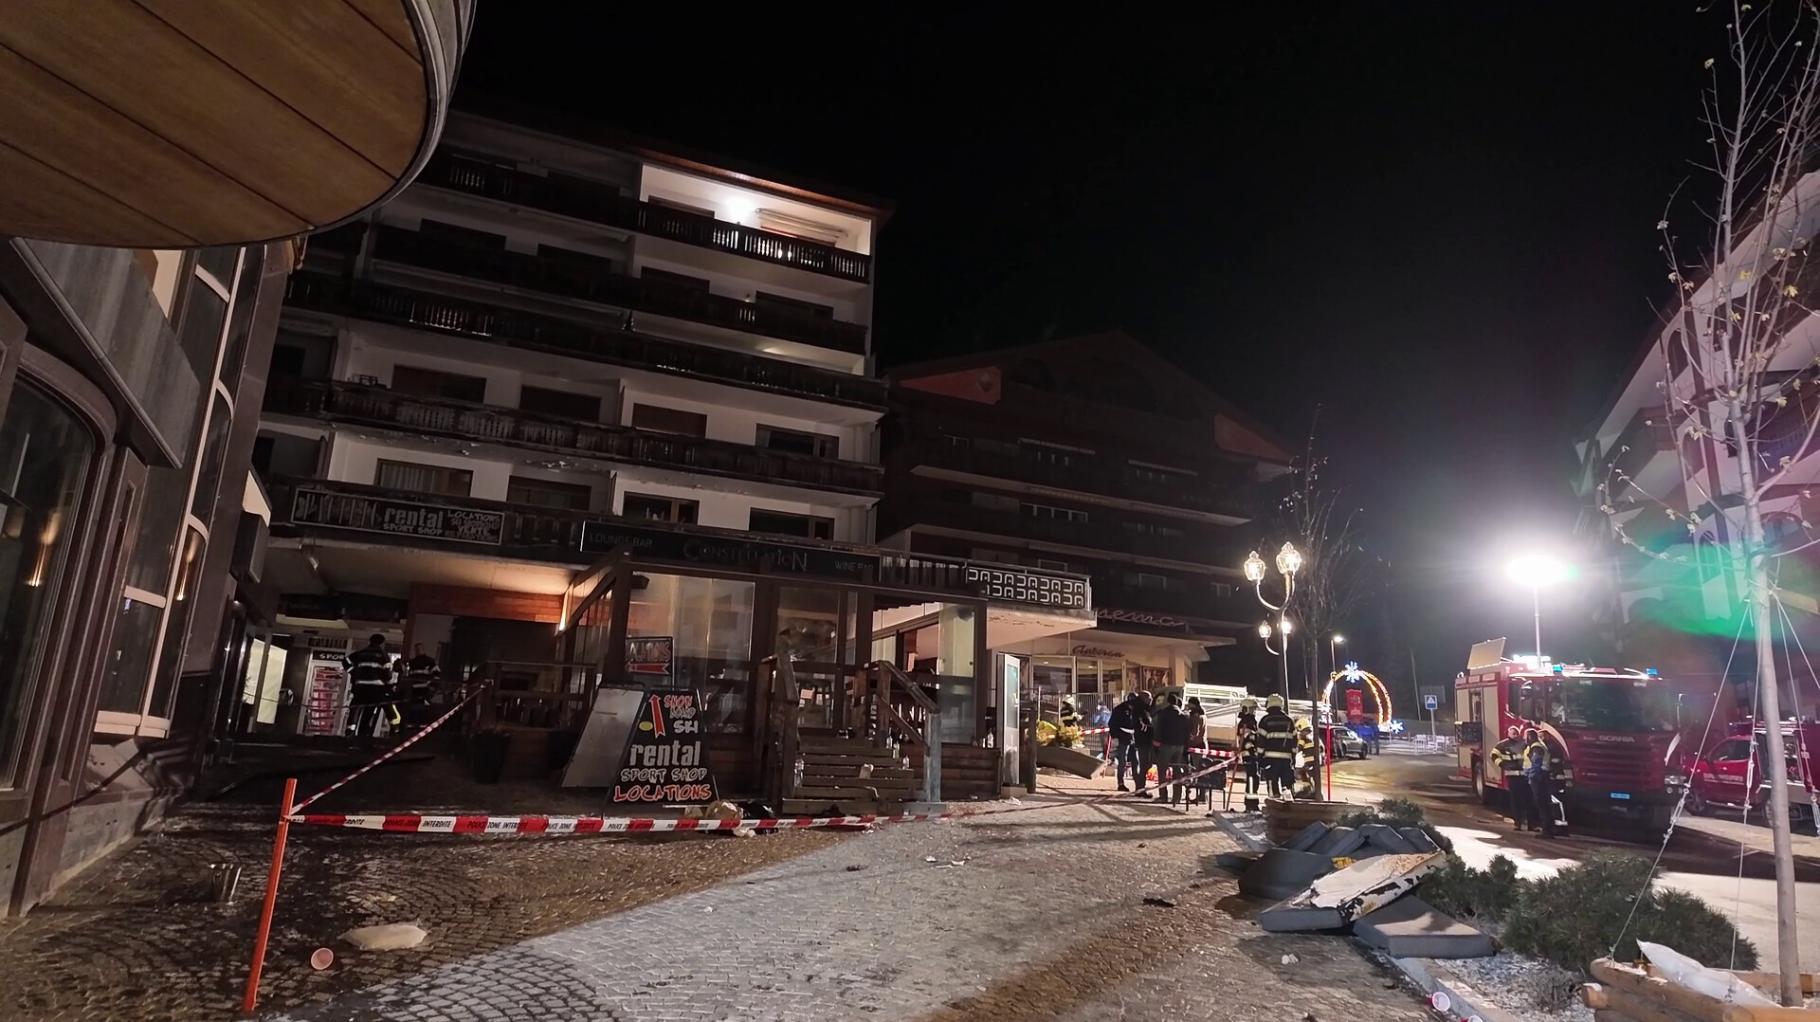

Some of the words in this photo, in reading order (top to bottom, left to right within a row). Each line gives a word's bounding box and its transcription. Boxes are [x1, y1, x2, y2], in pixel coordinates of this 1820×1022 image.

[384, 507, 443, 528] rental
[629, 740, 701, 767] rental
[620, 768, 667, 784] SPORT
[671, 767, 708, 782] SHOP
[613, 783, 712, 802] LOCATIONS
[422, 820, 452, 828] INTERDITE
